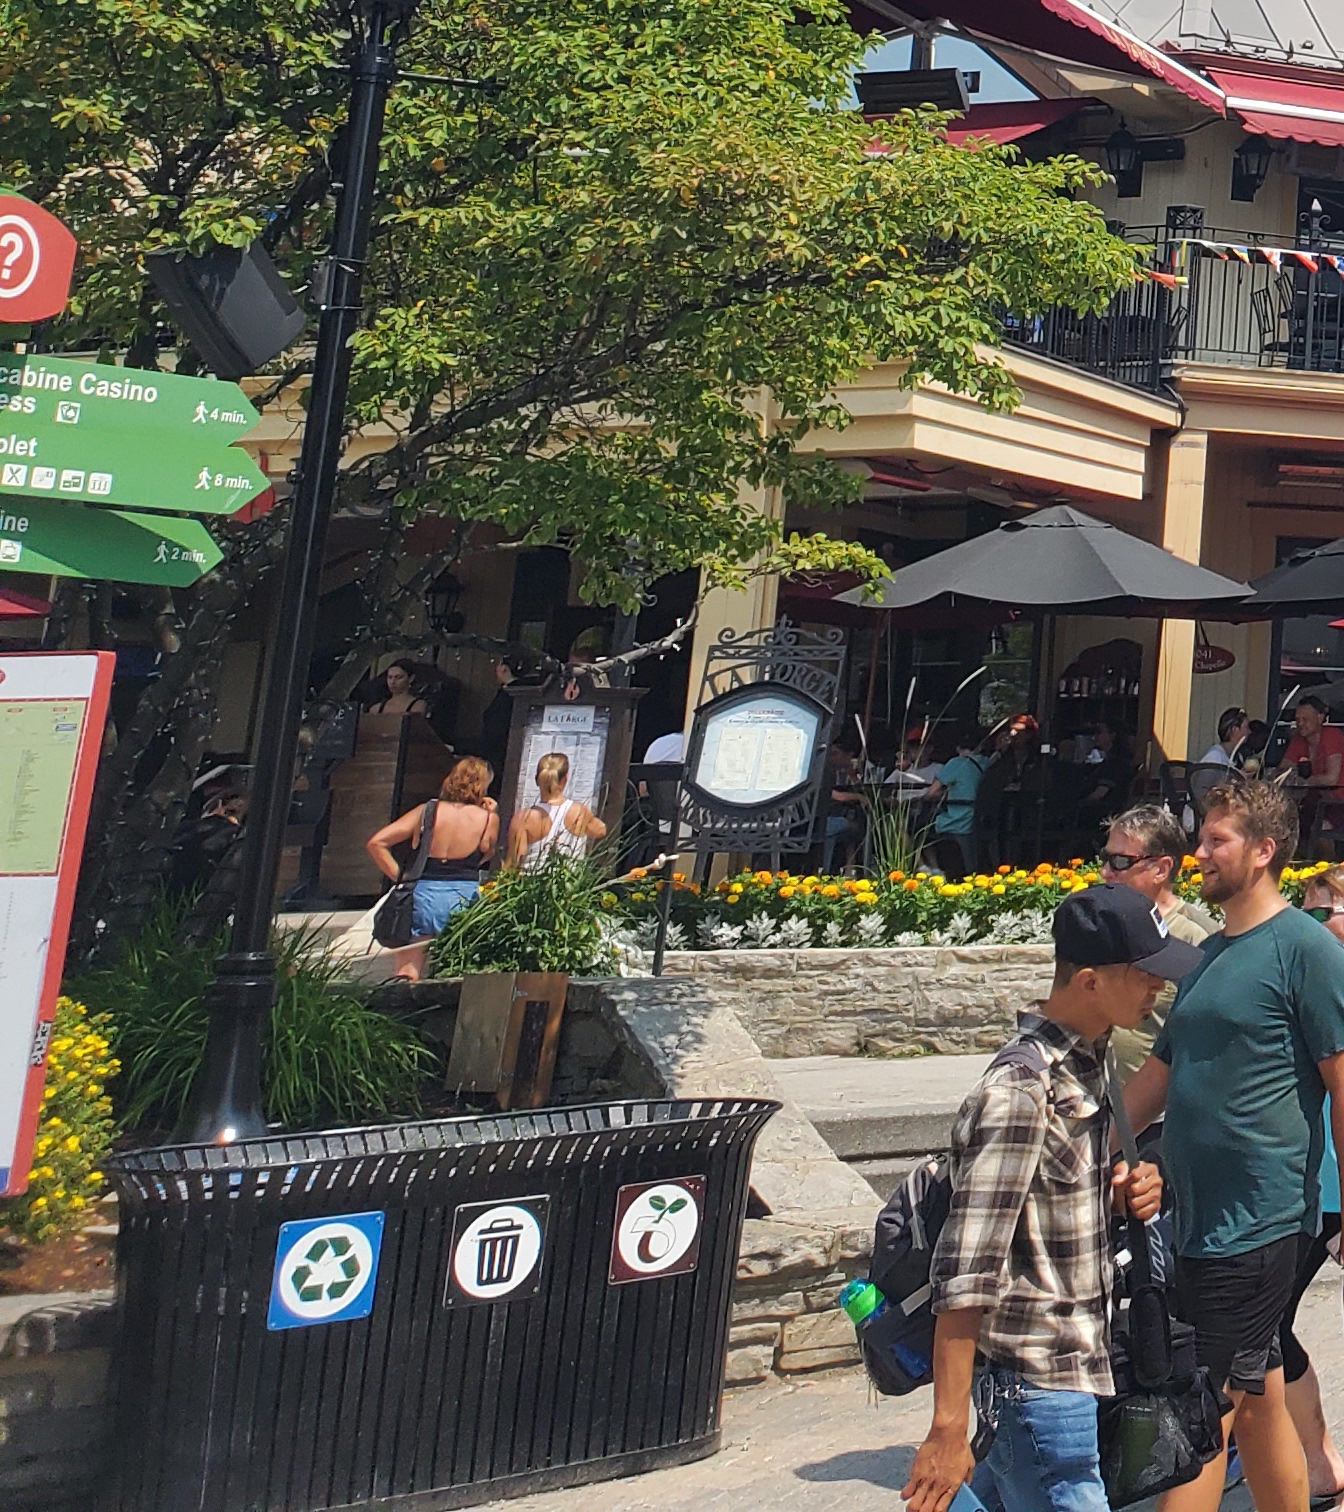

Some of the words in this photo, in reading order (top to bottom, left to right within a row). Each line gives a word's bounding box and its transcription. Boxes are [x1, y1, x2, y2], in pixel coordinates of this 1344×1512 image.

[0, 365, 73, 392] cabine
[80, 373, 158, 403] Casino
[0, 394, 36, 414] ess
[209, 407, 219, 421] 4
[221, 409, 247, 425] min.
[214, 473, 223, 486] 8
[225, 475, 253, 490] min.
[171, 547, 180, 560] 2
[181, 549, 207, 564] min.
[758, 661, 838, 699] FORGE
